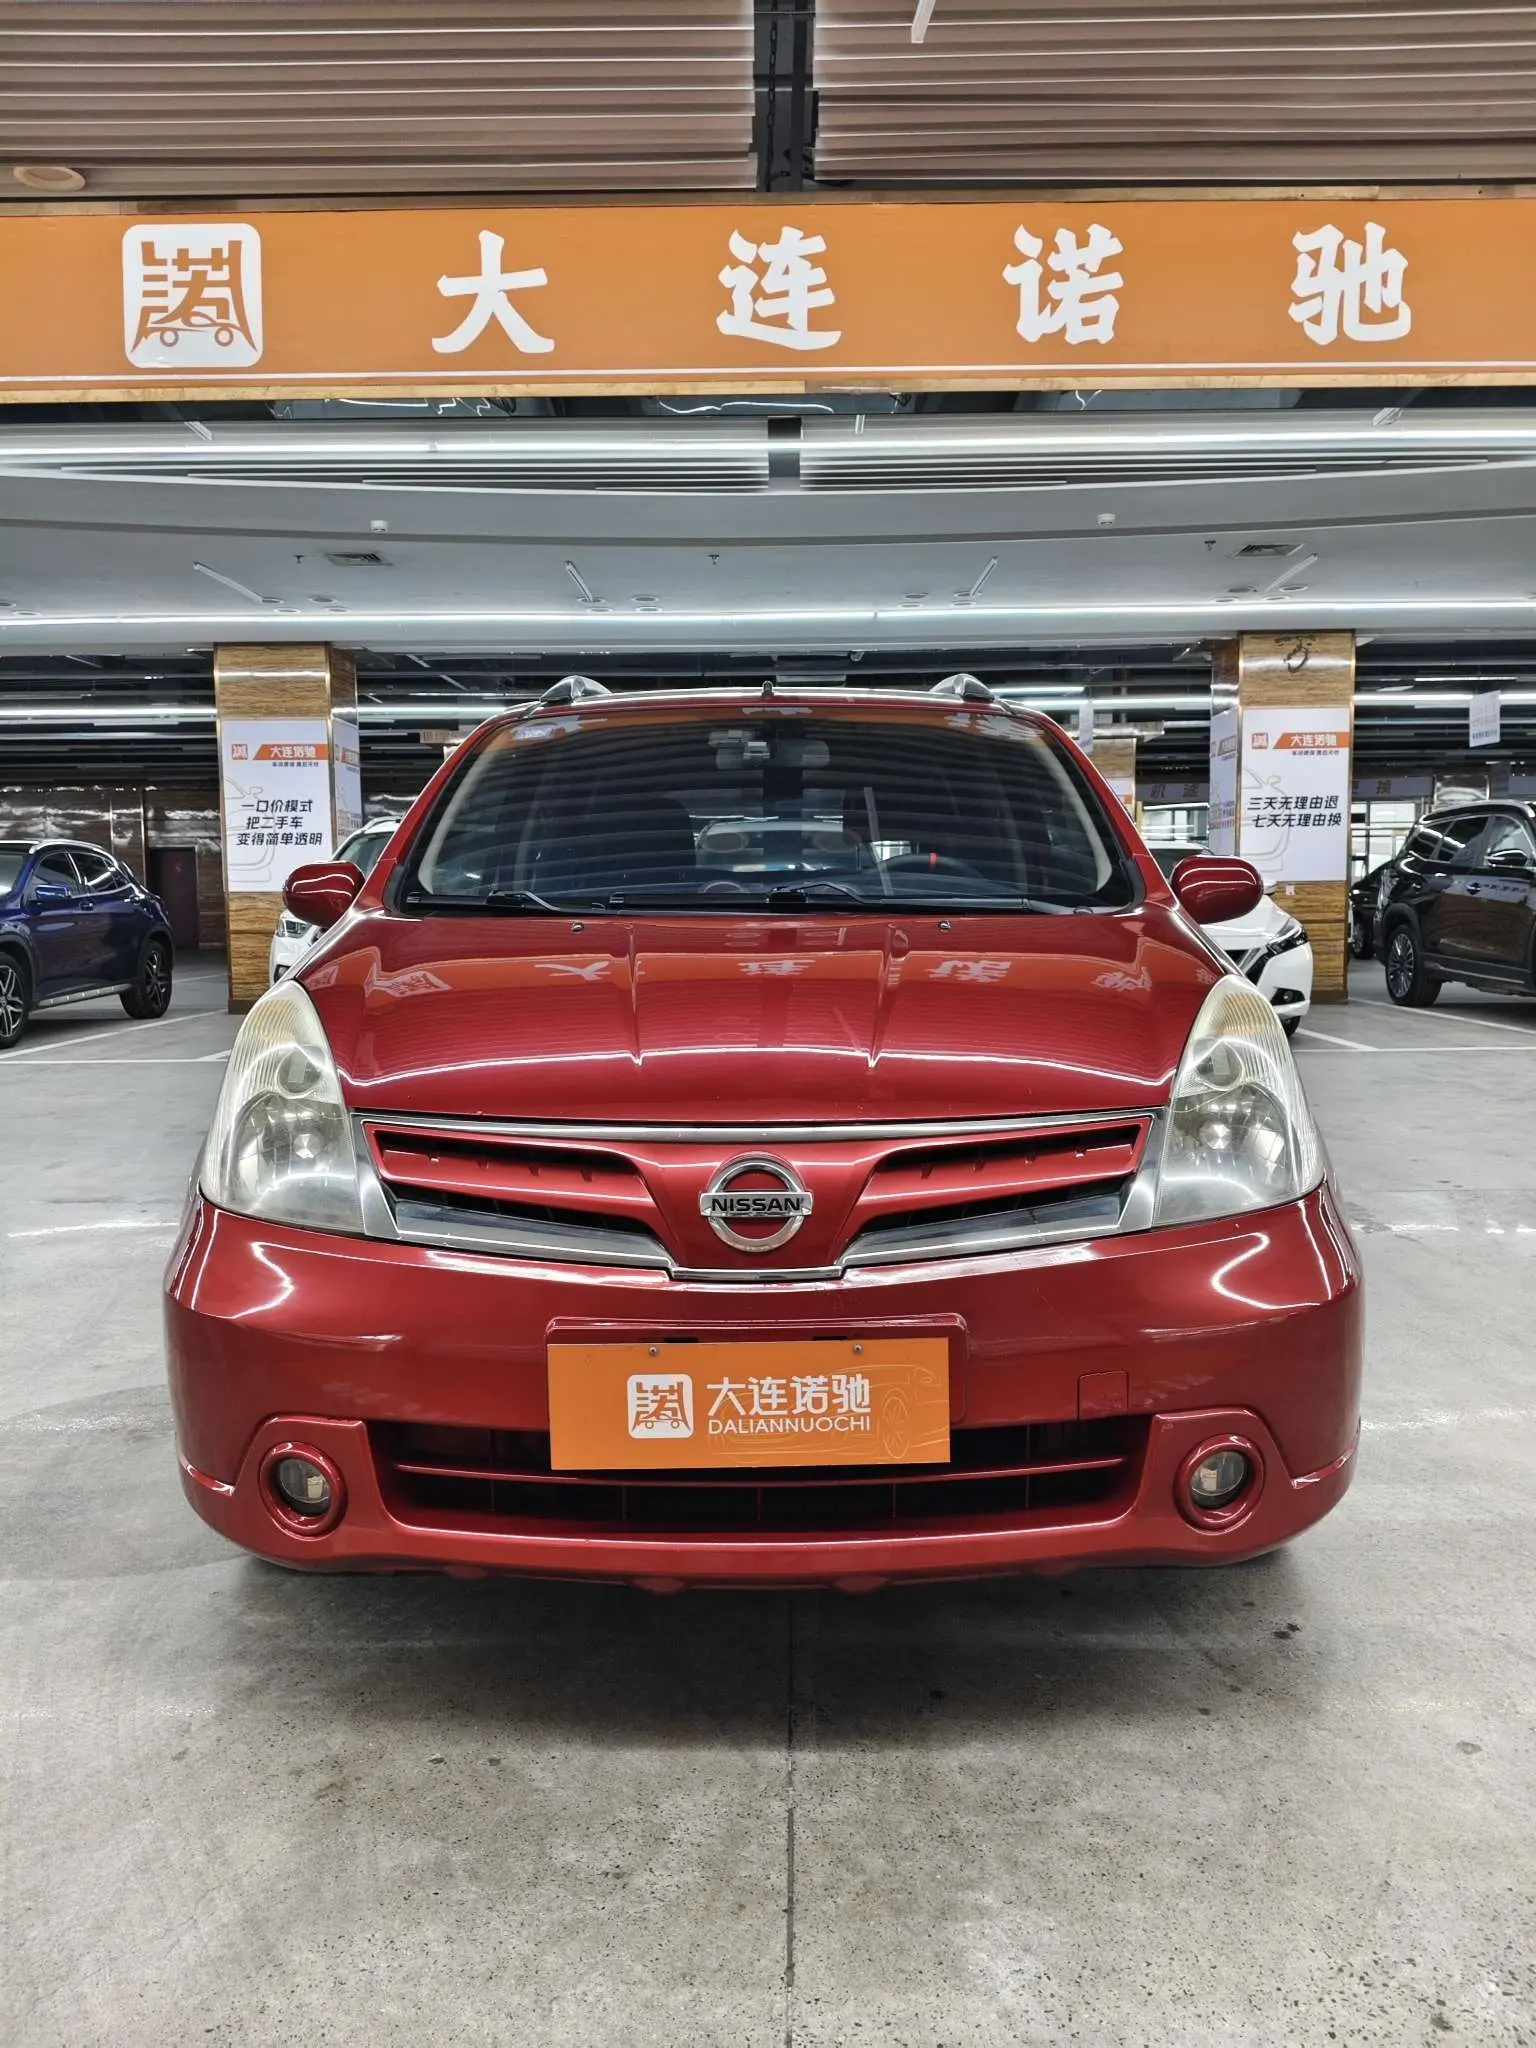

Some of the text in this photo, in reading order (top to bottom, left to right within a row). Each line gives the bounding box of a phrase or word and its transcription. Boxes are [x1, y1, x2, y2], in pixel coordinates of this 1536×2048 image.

[432, 222, 1411, 353] 大连诺驰
[241, 800, 313, 813] 一口价模式
[1247, 795, 1339, 811] 三天无理由退
[246, 816, 303, 830] 把二手车
[1252, 813, 1342, 828] 七天无理由换
[236, 832, 323, 846] 变得简单透明
[711, 1197, 801, 1212] NISSAN
[707, 1374, 872, 1416] 大连诺驰
[708, 1416, 871, 1434] DALIANNUOCHI
